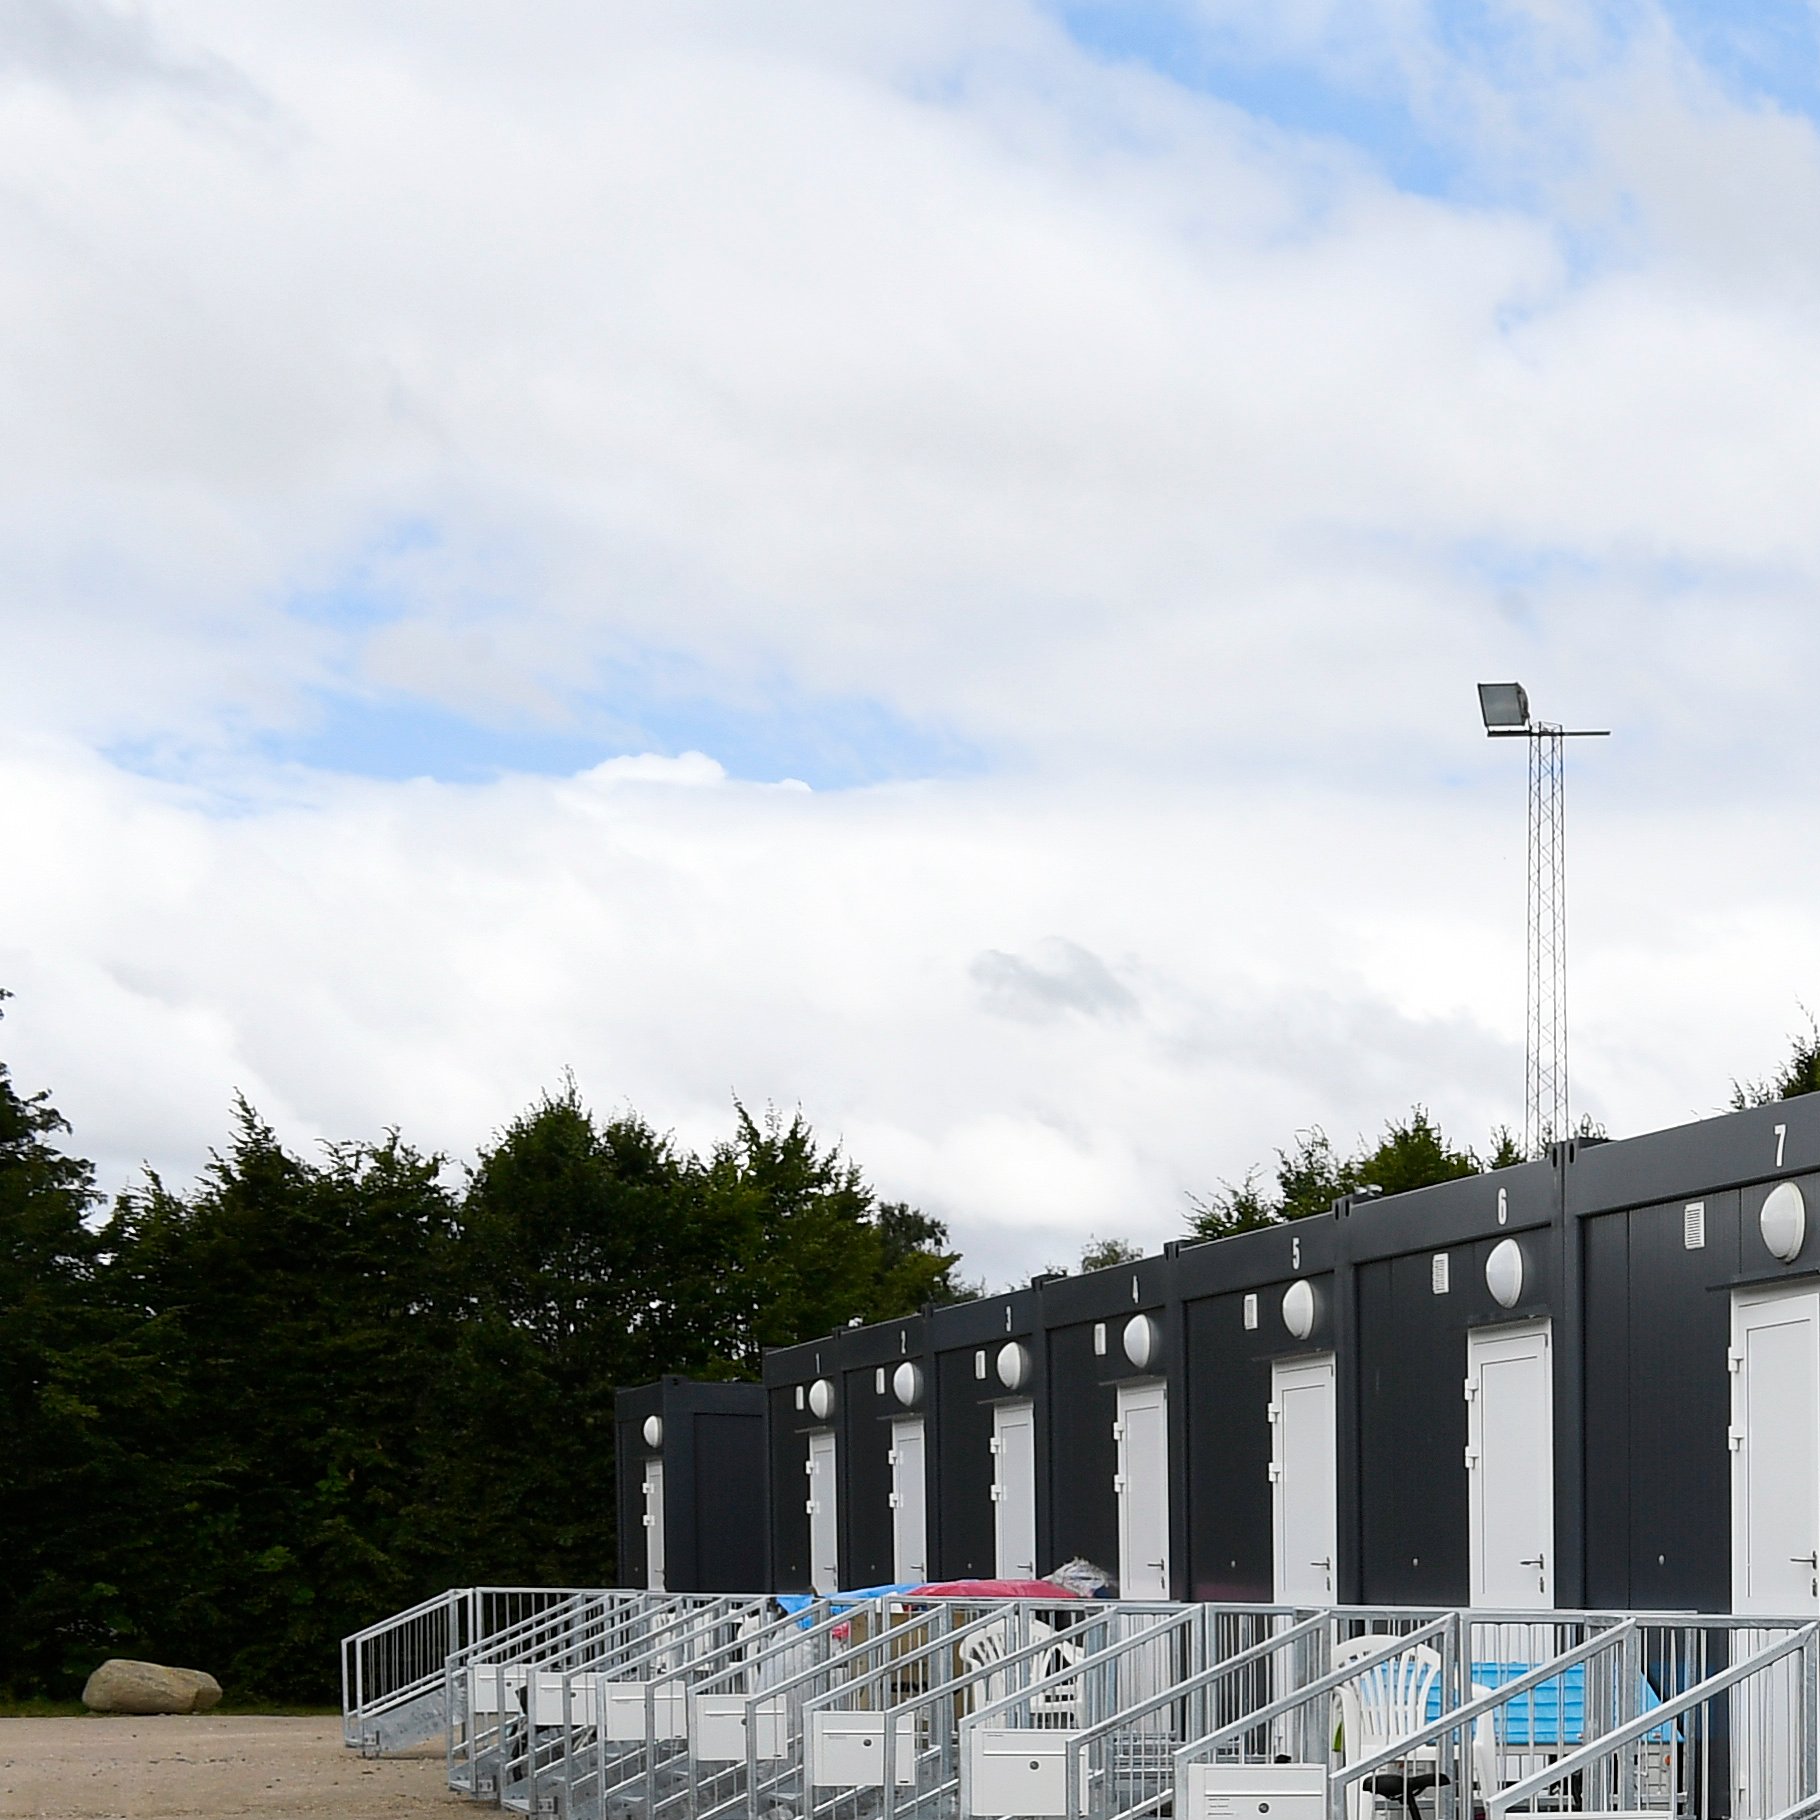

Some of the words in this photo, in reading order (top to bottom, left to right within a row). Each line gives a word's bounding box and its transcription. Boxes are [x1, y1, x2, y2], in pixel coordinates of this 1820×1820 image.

[1773, 1123, 1787, 1167] 7
[1498, 1187, 1507, 1225] 6
[1291, 1237, 1300, 1270] 5
[1131, 1275, 1139, 1304] 4
[1005, 1305, 1012, 1332] 3
[901, 1330, 906, 1354] 2
[815, 1353, 820, 1374] 1
